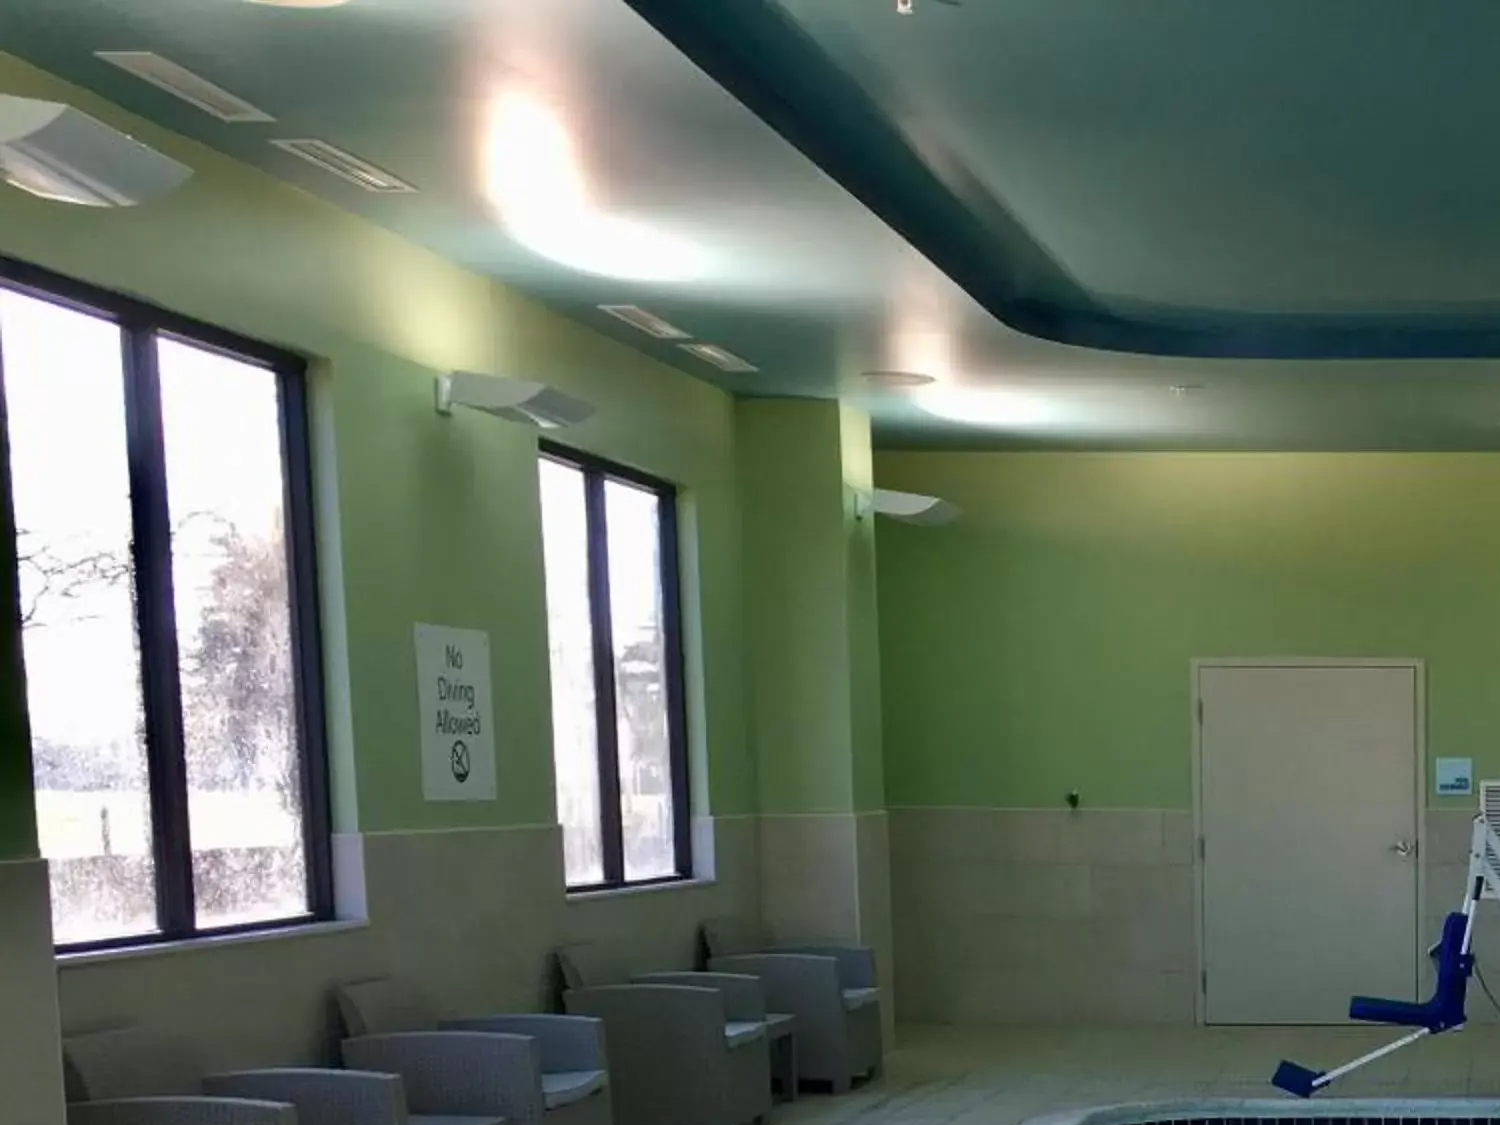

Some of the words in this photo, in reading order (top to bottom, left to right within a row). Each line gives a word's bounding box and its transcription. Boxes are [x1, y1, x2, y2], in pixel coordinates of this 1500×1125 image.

[446, 644, 463, 669] No
[437, 677, 475, 709] Diving
[436, 709, 481, 735] Allowed
